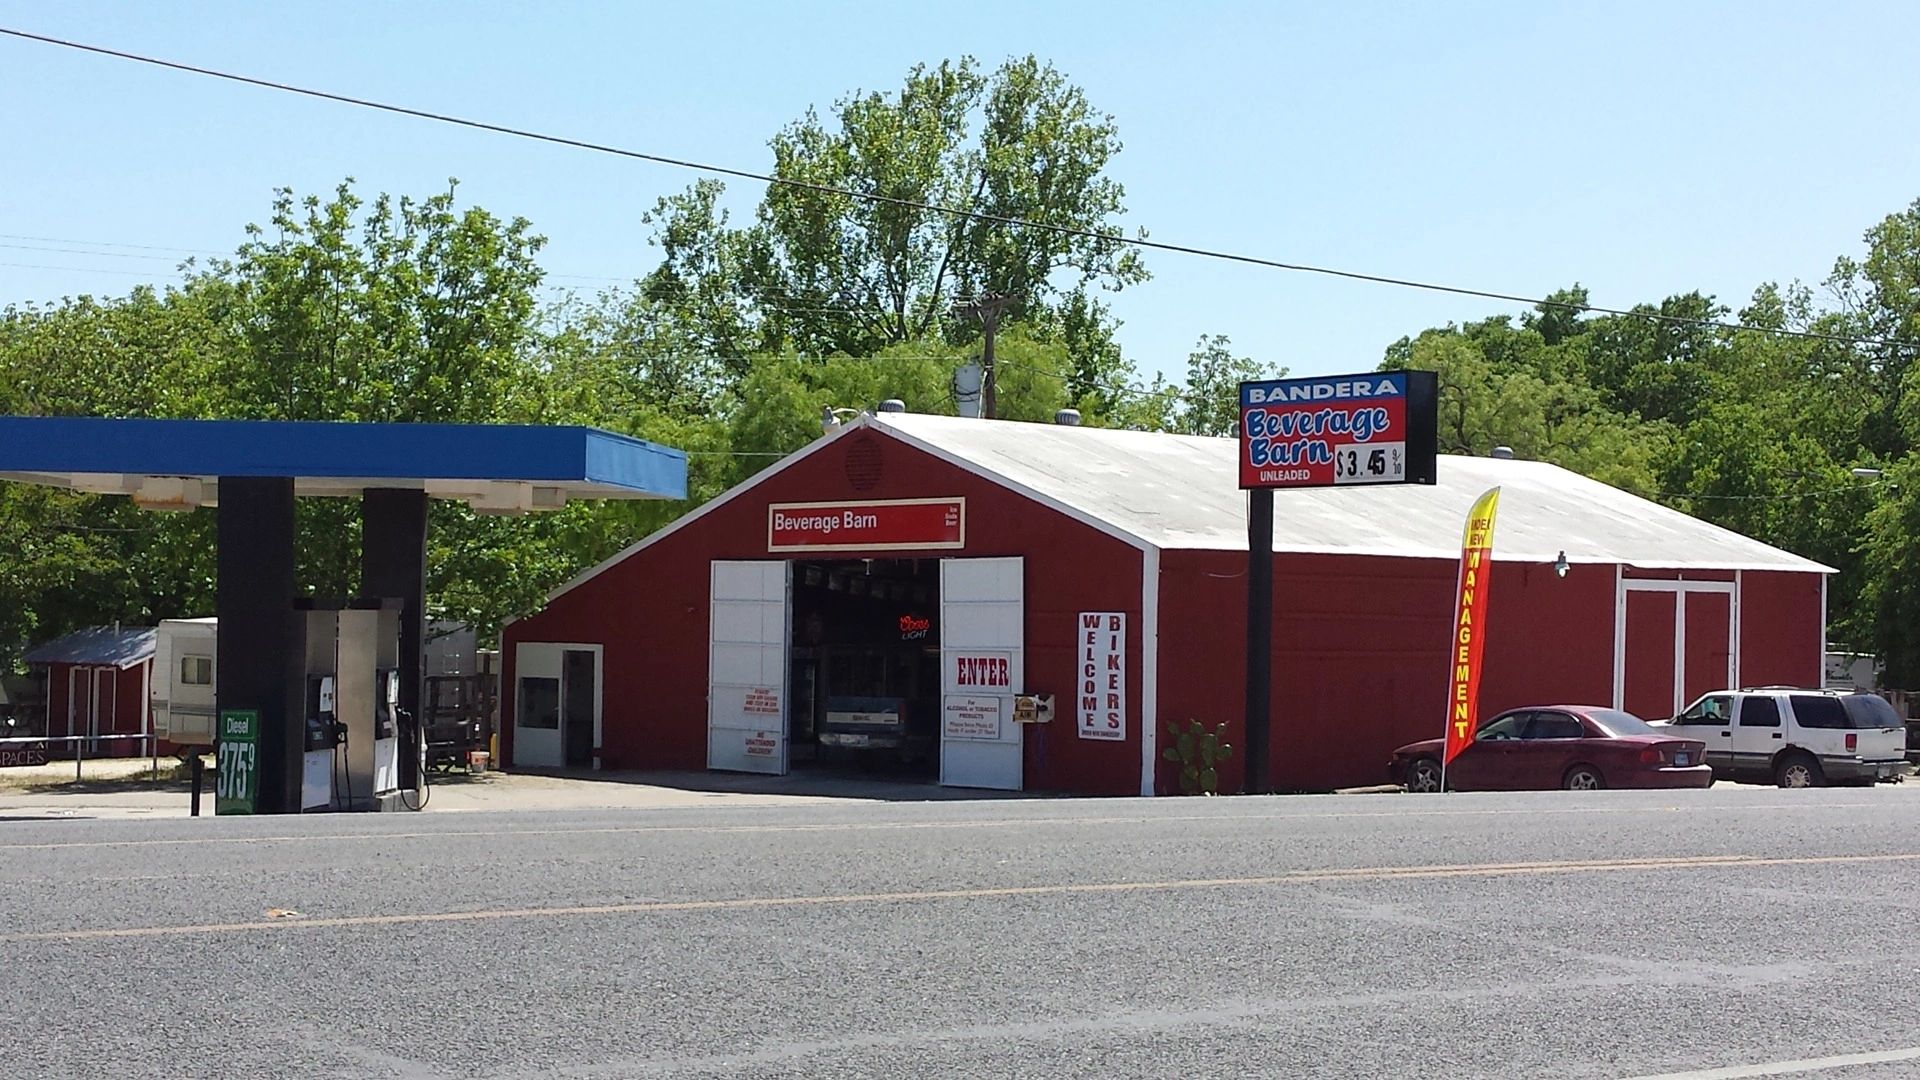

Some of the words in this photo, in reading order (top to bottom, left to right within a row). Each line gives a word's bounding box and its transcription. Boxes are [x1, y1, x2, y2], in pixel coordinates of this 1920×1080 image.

[1250, 379, 1399, 403] BANDERA
[1245, 407, 1391, 442] Beverage
[1249, 437, 1335, 467] Barn
[1260, 469, 1311, 482] UNLEADED
[774, 513, 840, 534] Beverage
[843, 511, 877, 529] Barn
[1454, 551, 1480, 739] MANAGEMENT
[957, 657, 1009, 687] ENTER
[1082, 614, 1101, 728] WELCOME
[1107, 615, 1121, 729] BIKERS
[226, 717, 249, 734] Diesel
[0, 750, 45, 766] PACES
